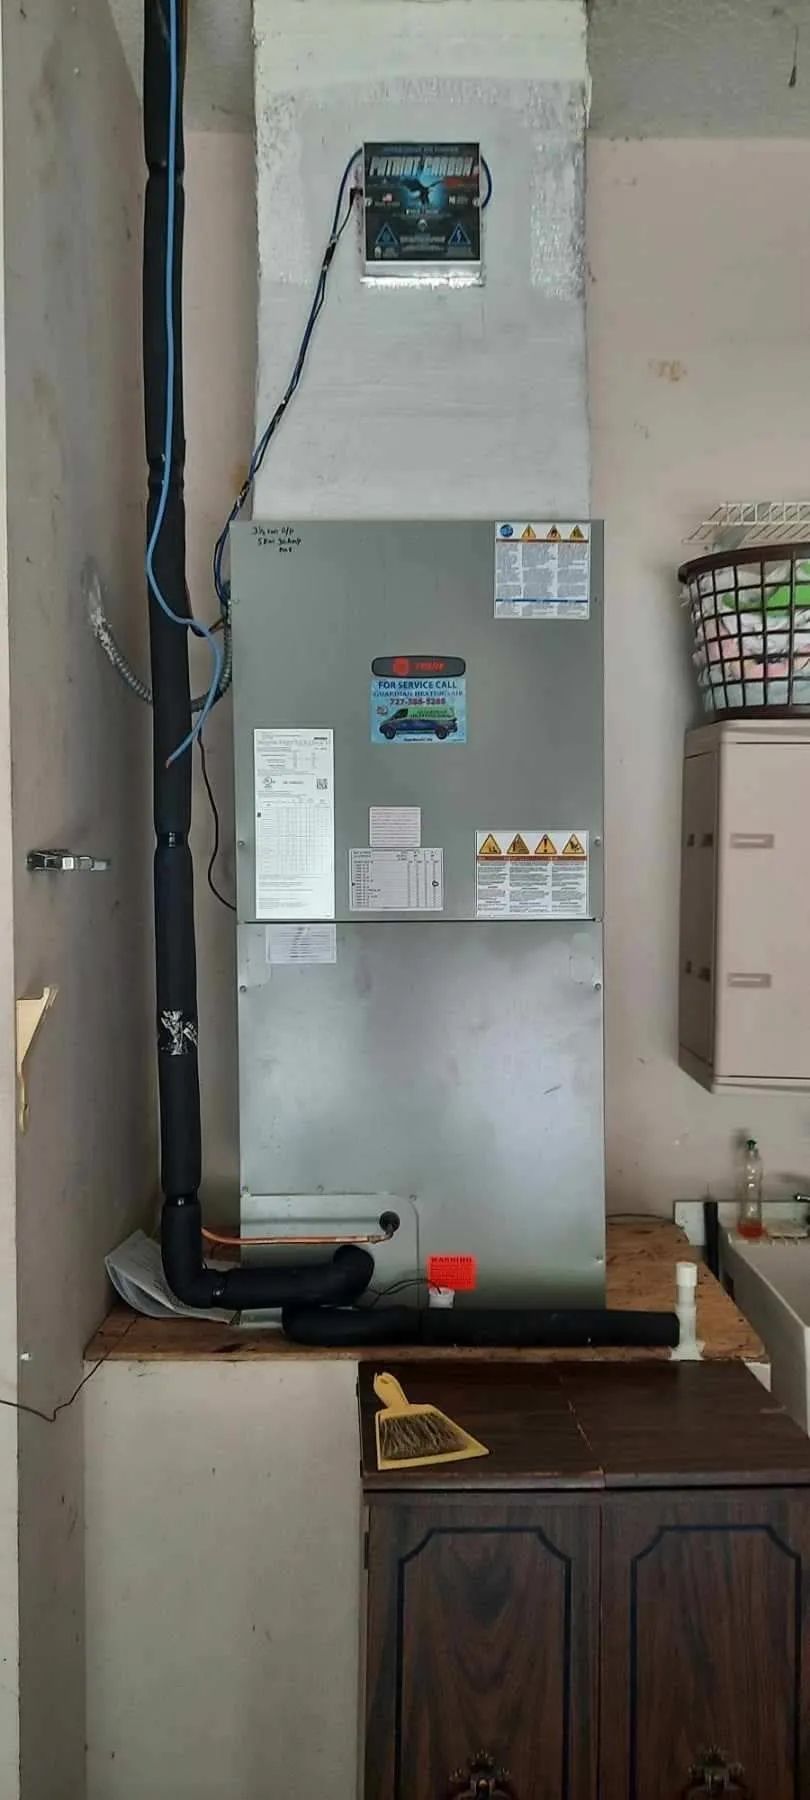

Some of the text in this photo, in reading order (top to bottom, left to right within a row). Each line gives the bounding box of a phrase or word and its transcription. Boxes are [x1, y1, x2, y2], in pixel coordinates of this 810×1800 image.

[369, 156, 473, 176] PATRIOT CARBON
[378, 681, 457, 689] FOR SERVICE CALL
